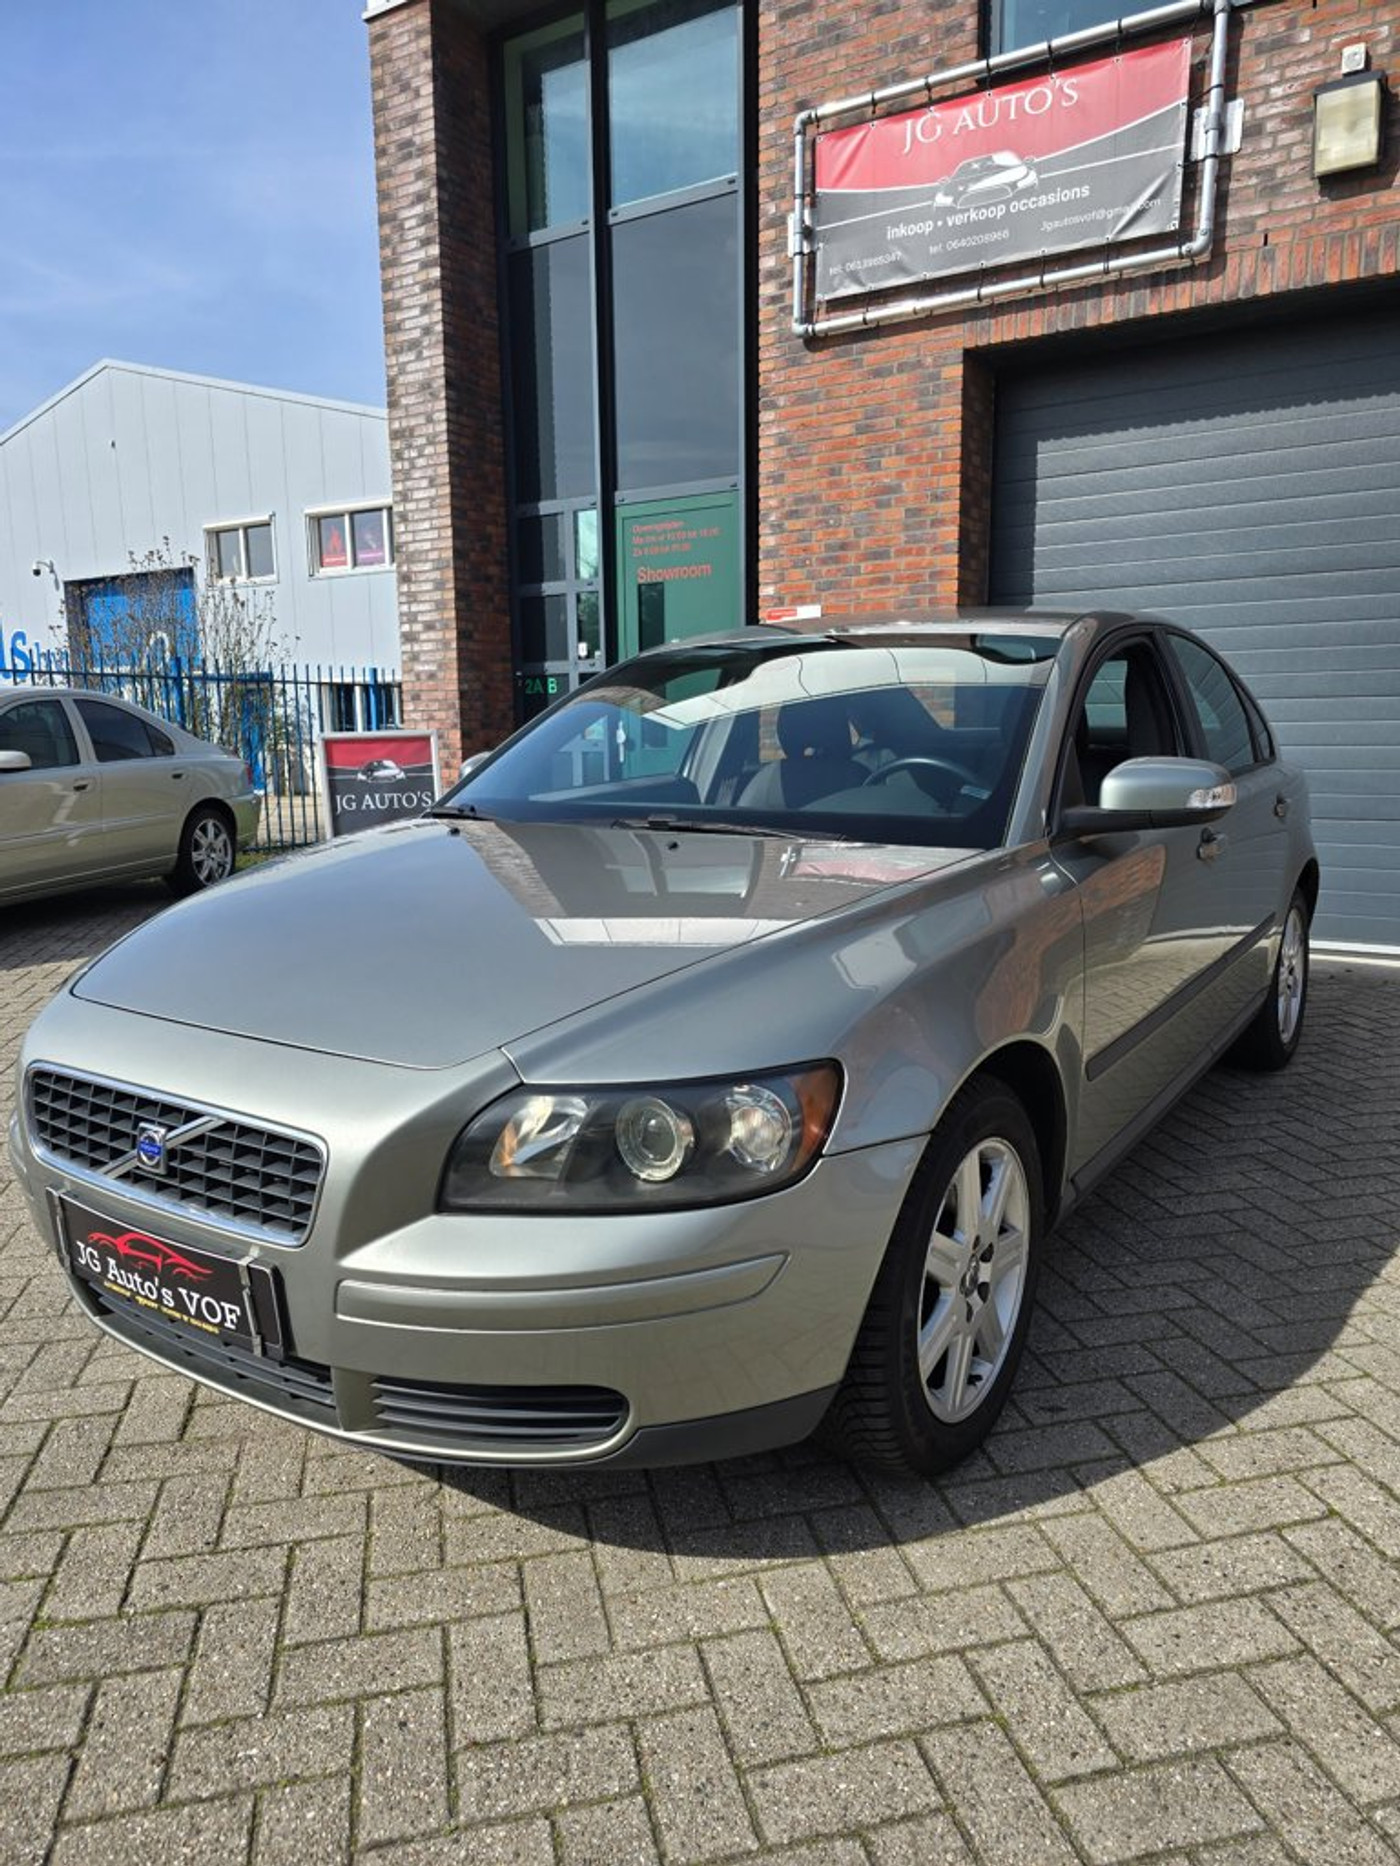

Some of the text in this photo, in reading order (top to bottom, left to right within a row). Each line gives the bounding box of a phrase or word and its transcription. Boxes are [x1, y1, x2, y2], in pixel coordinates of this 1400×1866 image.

[904, 79, 1079, 154] JG AUTO'S
[886, 184, 1091, 241] inkoop verkoop occasions
[637, 564, 712, 583] Showroom
[525, 677, 558, 694] 2A B
[335, 790, 433, 815] JG AUTO'S
[76, 1240, 102, 1273] JG
[107, 1256, 175, 1307] Auto's
[177, 1287, 242, 1330] VOF
